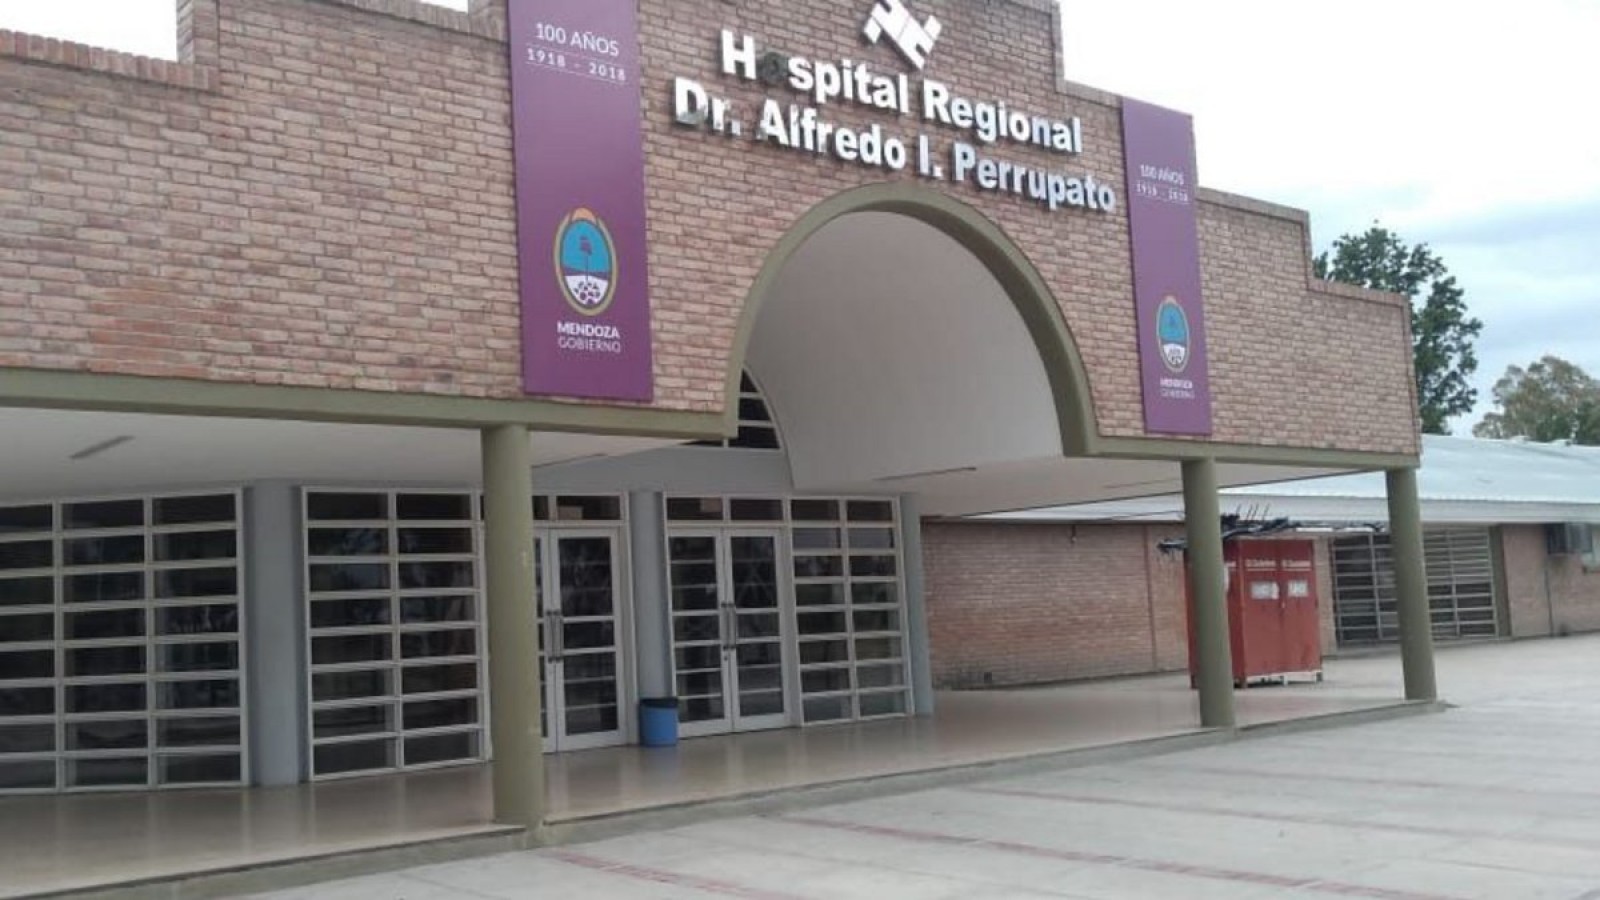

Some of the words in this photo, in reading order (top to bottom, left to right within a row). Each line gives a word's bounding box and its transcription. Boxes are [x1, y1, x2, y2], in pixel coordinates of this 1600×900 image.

[536, 22, 566, 45] 100
[570, 31, 619, 57] AÑOS
[527, 48, 566, 68] 1918
[589, 62, 625, 81] 2018
[720, 29, 909, 113] Hospital
[922, 79, 1083, 153] Regional
[674, 76, 742, 136] Dr.
[755, 98, 907, 170] Alfredo
[918, 134, 942, 178] I.
[953, 142, 1116, 212] Perrupato
[557, 320, 620, 339] MENDOZA
[558, 336, 621, 353] GOBIERNO
